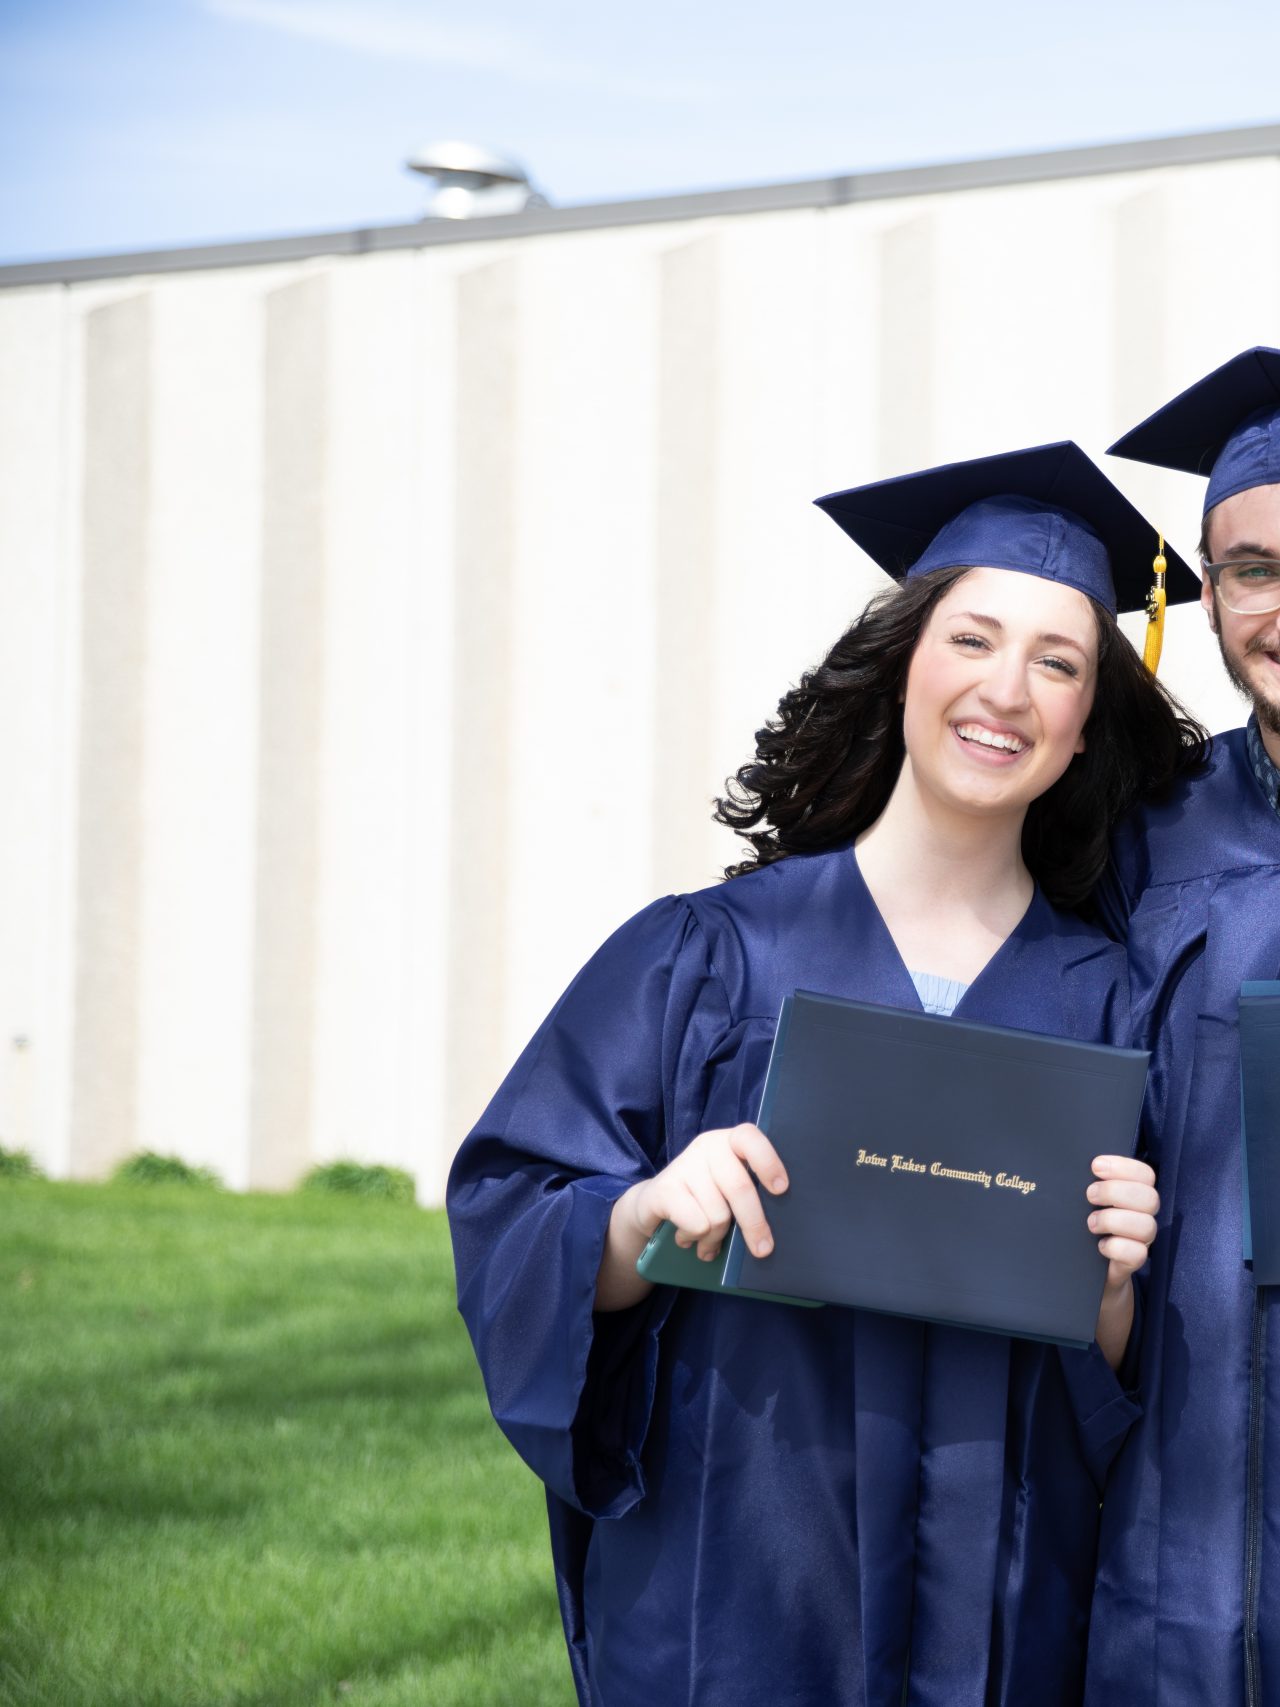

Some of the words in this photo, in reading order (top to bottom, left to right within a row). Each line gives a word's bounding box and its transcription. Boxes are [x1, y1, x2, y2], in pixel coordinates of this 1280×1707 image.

[856, 1149, 888, 1167] Iowa
[890, 1154, 927, 1173] Lakes
[930, 1162, 992, 1188] Community
[995, 1172, 1037, 1195] College
